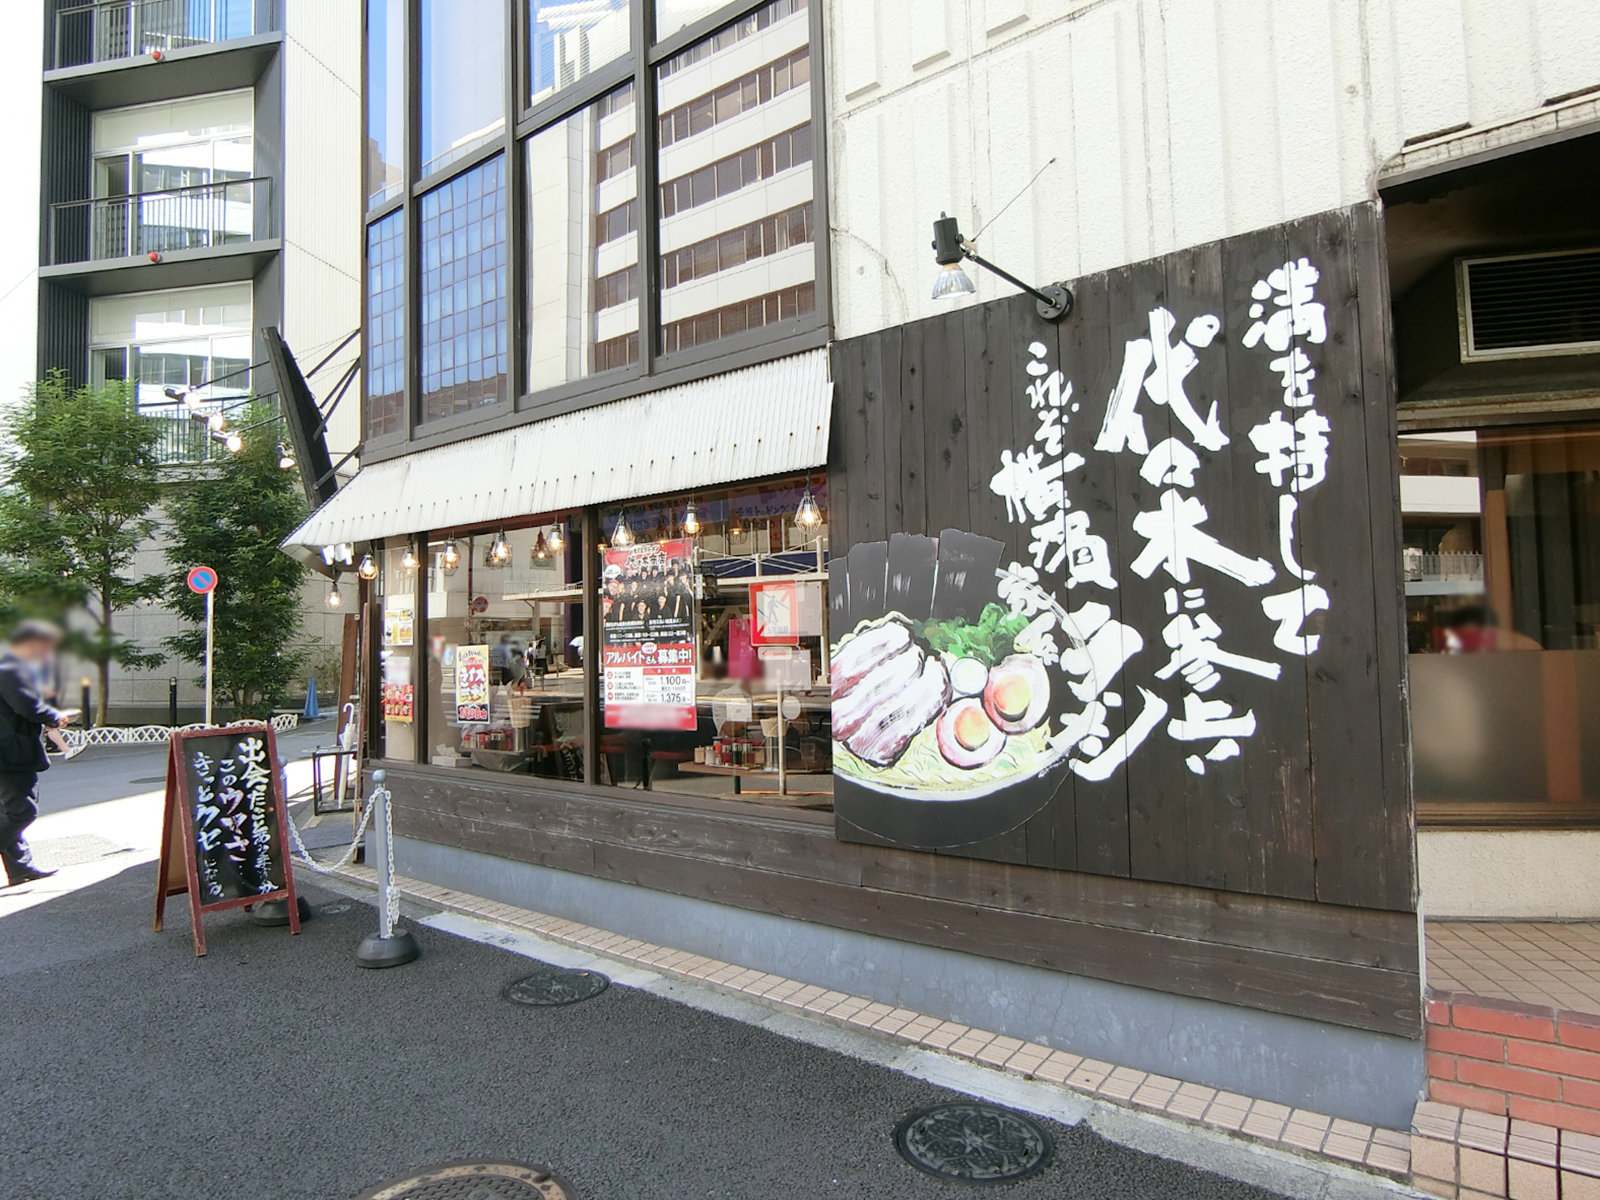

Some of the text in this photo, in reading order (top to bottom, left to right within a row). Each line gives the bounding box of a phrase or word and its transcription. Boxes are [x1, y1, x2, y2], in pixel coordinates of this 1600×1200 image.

[1241, 256, 1332, 657] 満を持して
